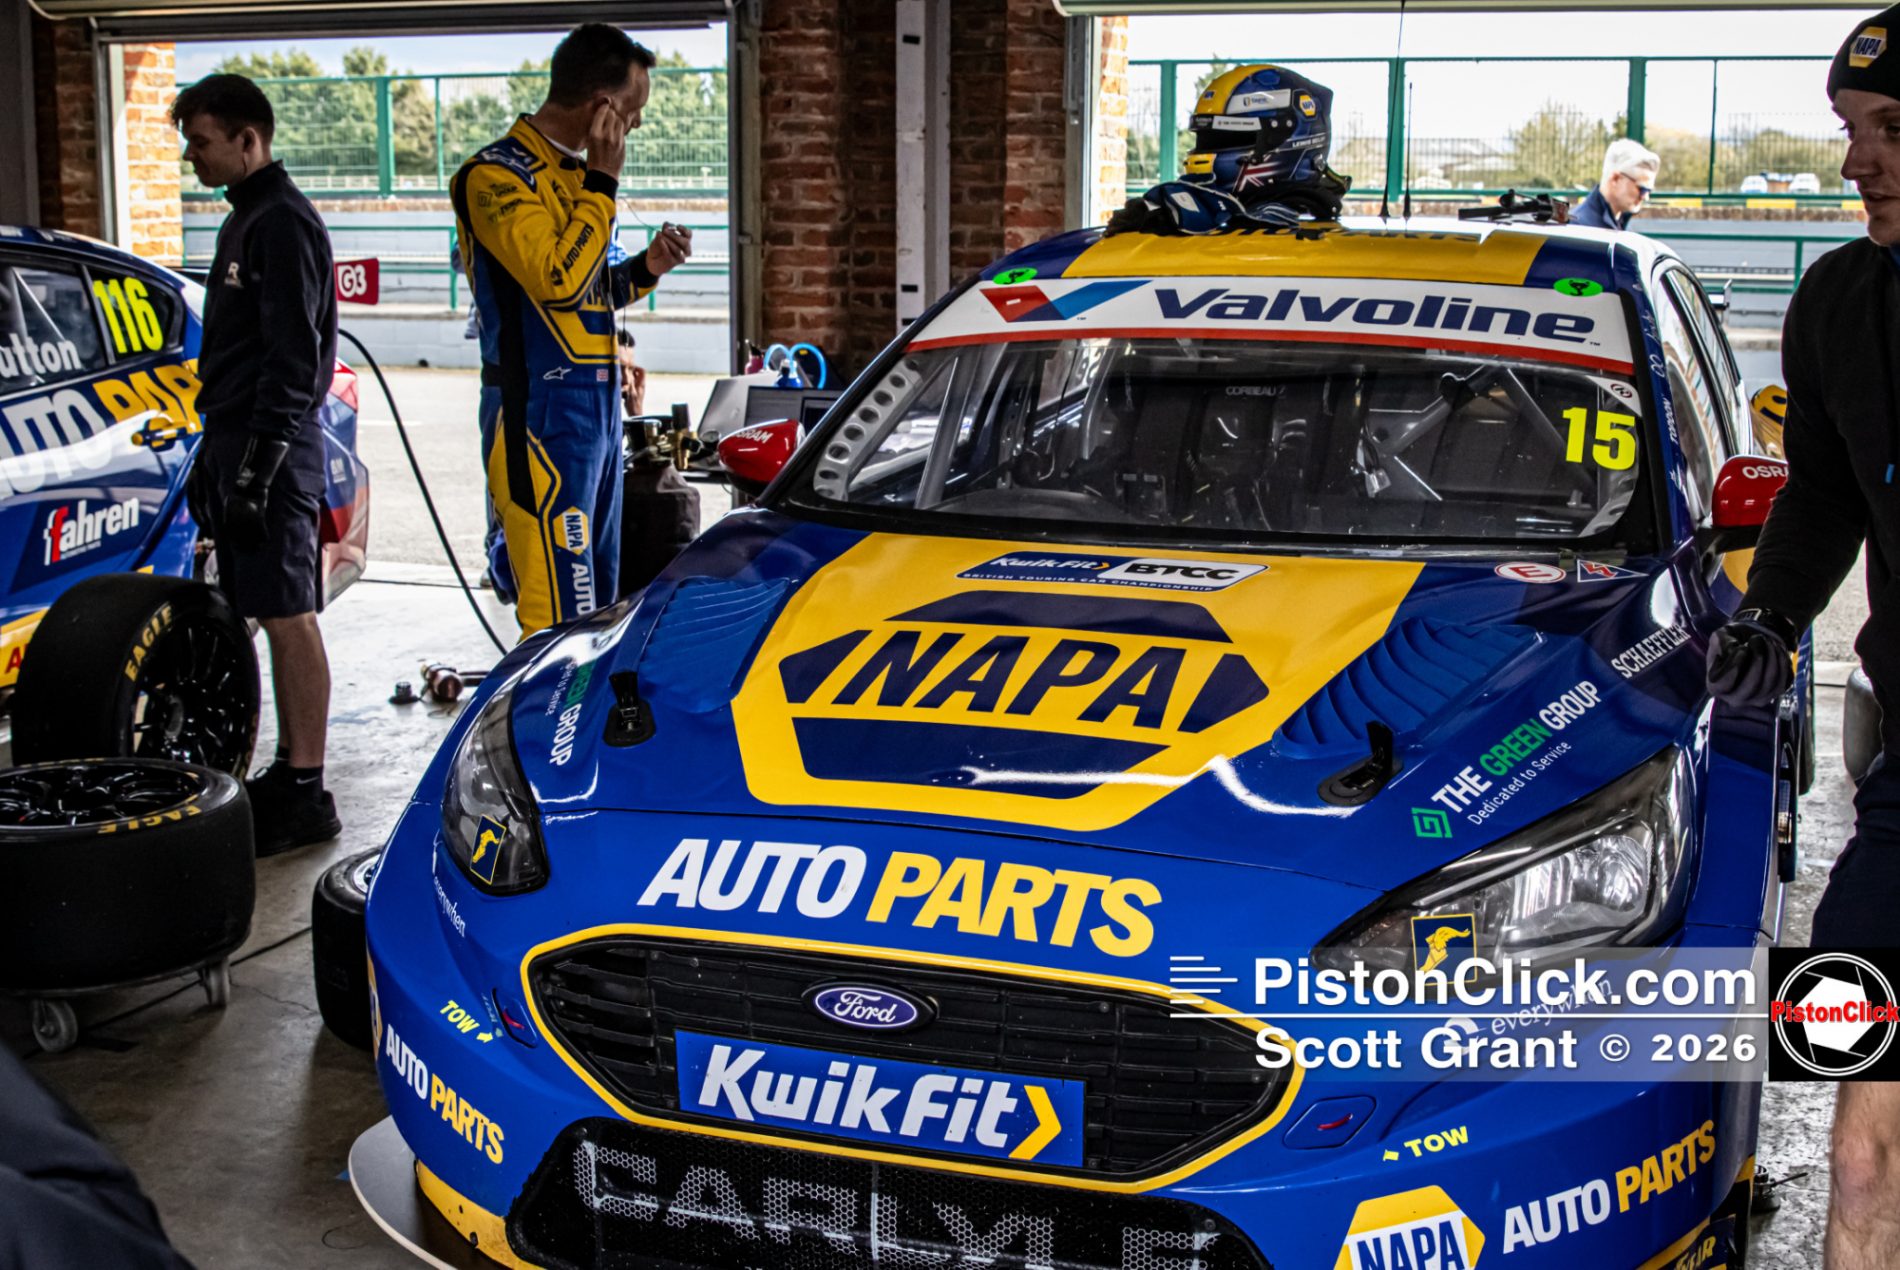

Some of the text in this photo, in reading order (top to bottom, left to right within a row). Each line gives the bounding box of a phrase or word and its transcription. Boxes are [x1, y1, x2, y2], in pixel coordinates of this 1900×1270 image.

[92, 277, 163, 353] 116
[1154, 289, 1595, 343] Valvoline
[1562, 407, 1636, 471] 15
[43, 498, 138, 566] fahren
[565, 514, 583, 550] NAPA
[571, 562, 593, 616] AUTO
[1112, 580, 1213, 591] CHAMPIONSHIP
[1124, 563, 1239, 580] BTCC
[831, 630, 1187, 730] NAPA
[1611, 622, 1692, 679] SCHAEFFLER
[549, 703, 582, 766] GROUP
[1431, 680, 1601, 813] THE GREEN GROUP
[1467, 741, 1572, 825] Dedicated to Service
[637, 839, 1162, 957] AUTO PARTS
[440, 1000, 480, 1034] TOW
[834, 988, 897, 1025] Ford
[386, 1023, 504, 1165] AUTO PARTS
[1404, 1125, 1469, 1158] TOW
[1503, 1119, 1716, 1255] AUTO PARTS
[1356, 1220, 1465, 1270] NAPA
